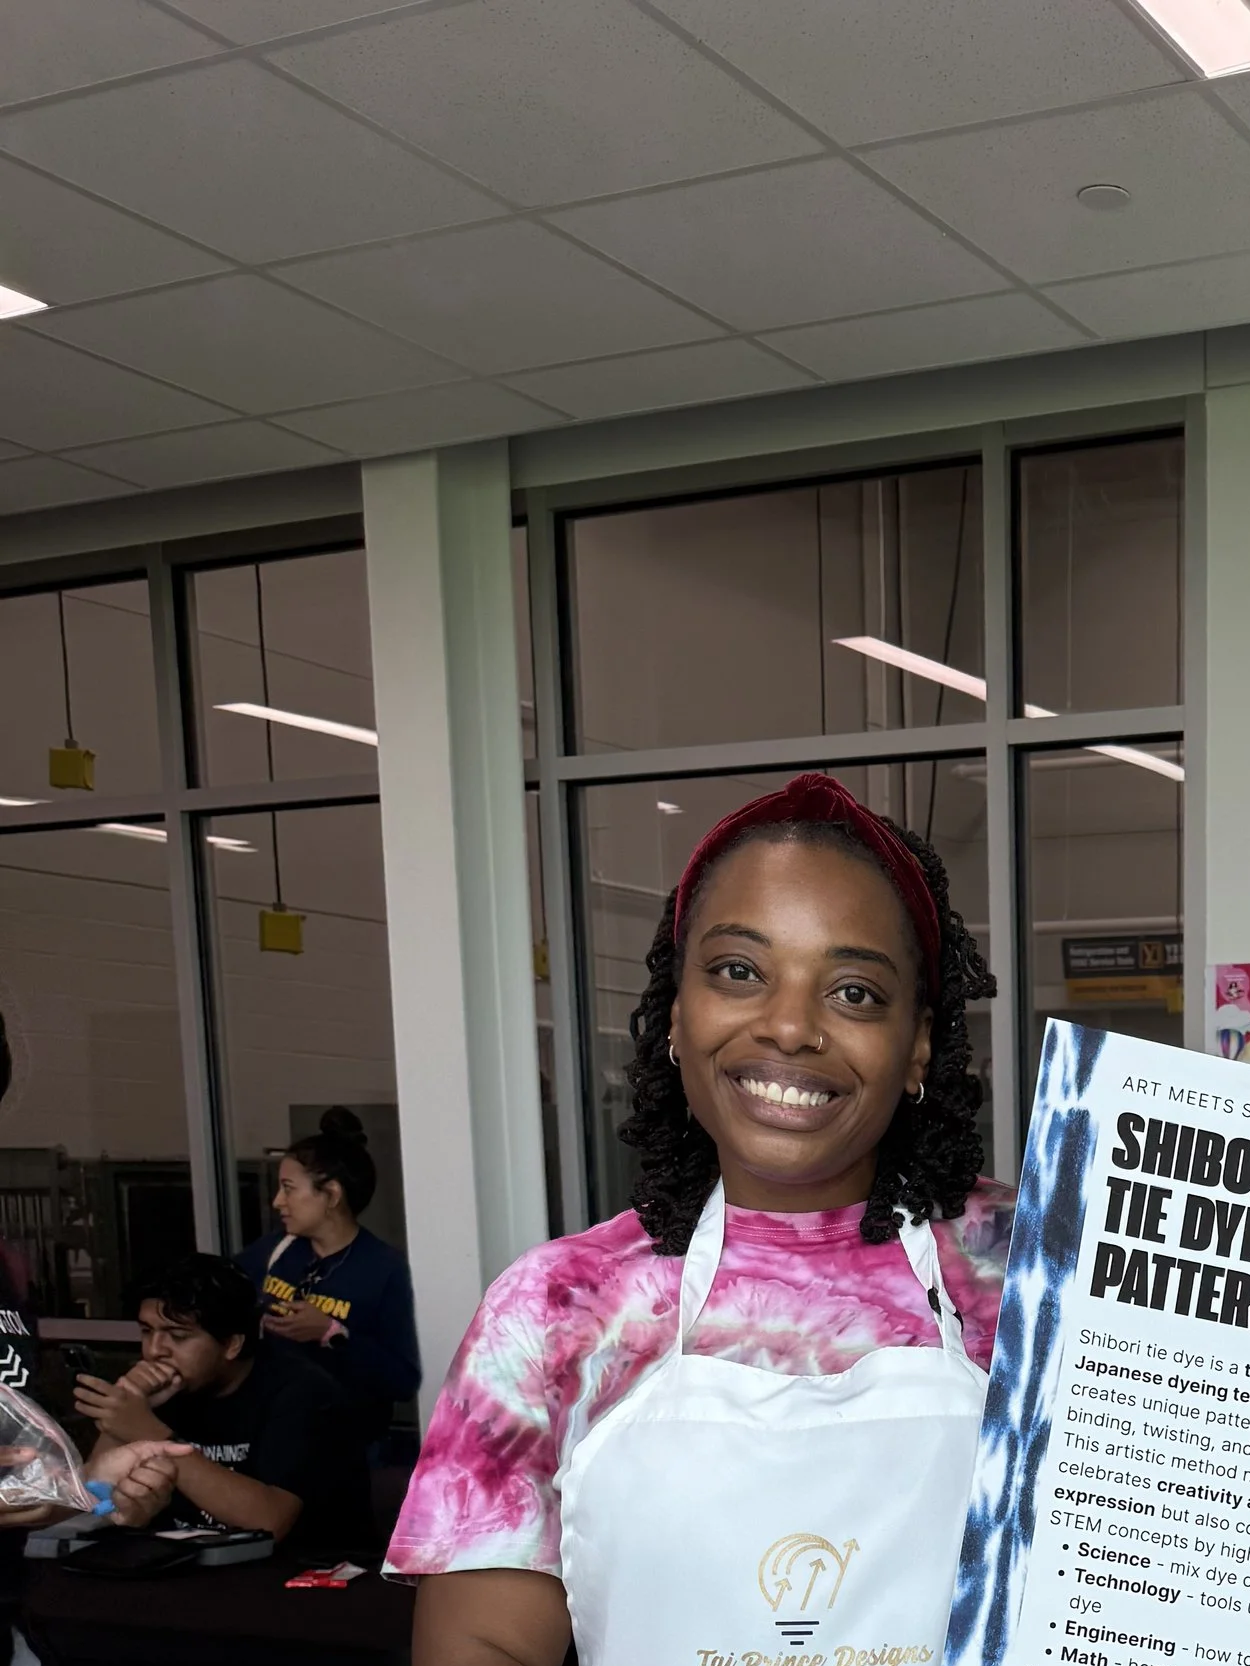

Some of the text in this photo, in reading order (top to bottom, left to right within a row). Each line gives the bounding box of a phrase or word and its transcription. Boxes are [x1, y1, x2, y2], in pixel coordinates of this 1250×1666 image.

[1121, 1075, 1162, 1097] ART
[1168, 1085, 1235, 1114] MEETS
[1103, 1175, 1174, 1245] TIE
[1079, 1328, 1141, 1356] Shibori
[1146, 1343, 1168, 1361] tie
[1172, 1349, 1205, 1369] dye
[1209, 1355, 1224, 1372] is
[1228, 1362, 1239, 1375] a
[1070, 1383, 1137, 1407] creates
[1142, 1397, 1201, 1420] unique
[1074, 1355, 1163, 1386] Japanese
[1167, 1374, 1229, 1403] dyeing
[1066, 1405, 1136, 1437] binding,
[1143, 1421, 1215, 1453] twisting,
[1063, 1431, 1100, 1453] This
[1104, 1443, 1166, 1466] artistic
[1170, 1456, 1238, 1480] method
[1058, 1461, 1152, 1490] celebrates
[1156, 1480, 1244, 1510] creativity
[1053, 1487, 1156, 1517] expression
[1161, 1503, 1190, 1524] but
[1194, 1512, 1230, 1531] also
[1049, 1509, 1102, 1534] STEM
[1107, 1523, 1189, 1550] concepts
[1194, 1536, 1216, 1558] by
[1077, 1541, 1151, 1569] Science
[1169, 1561, 1201, 1579] mix
[1205, 1566, 1238, 1587] dye
[1069, 1594, 1102, 1615] dye
[1074, 1567, 1182, 1604] Technology
[1200, 1591, 1242, 1613] tools
[1064, 1619, 1176, 1657] Engineering
[1194, 1642, 1232, 1663] how
